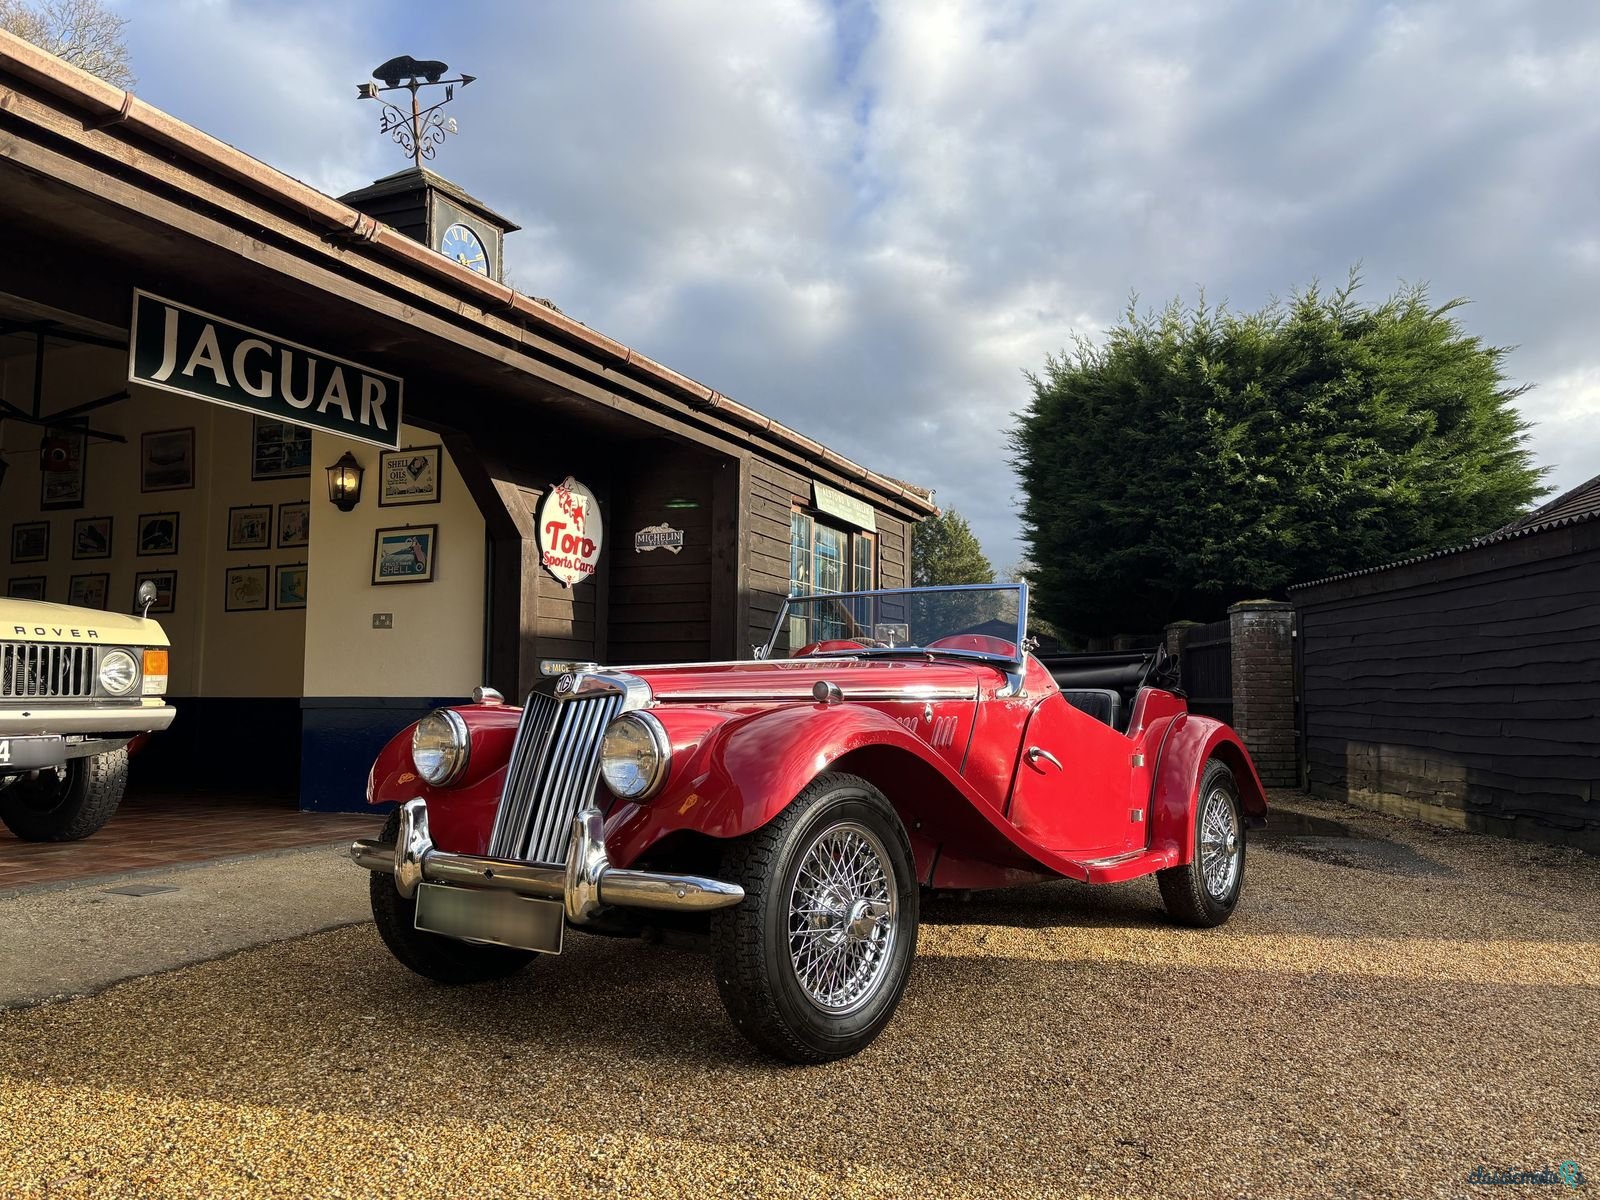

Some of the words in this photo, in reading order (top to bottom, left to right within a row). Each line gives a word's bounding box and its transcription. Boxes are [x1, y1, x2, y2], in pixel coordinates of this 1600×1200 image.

[151, 307, 388, 432] JAGUAR
[390, 471, 406, 479] OILS
[545, 521, 597, 558] Toro
[637, 532, 680, 543] MICHELIN
[543, 551, 573, 569] Sports
[382, 565, 412, 575] SHELL
[14, 626, 99, 638] ROVER
